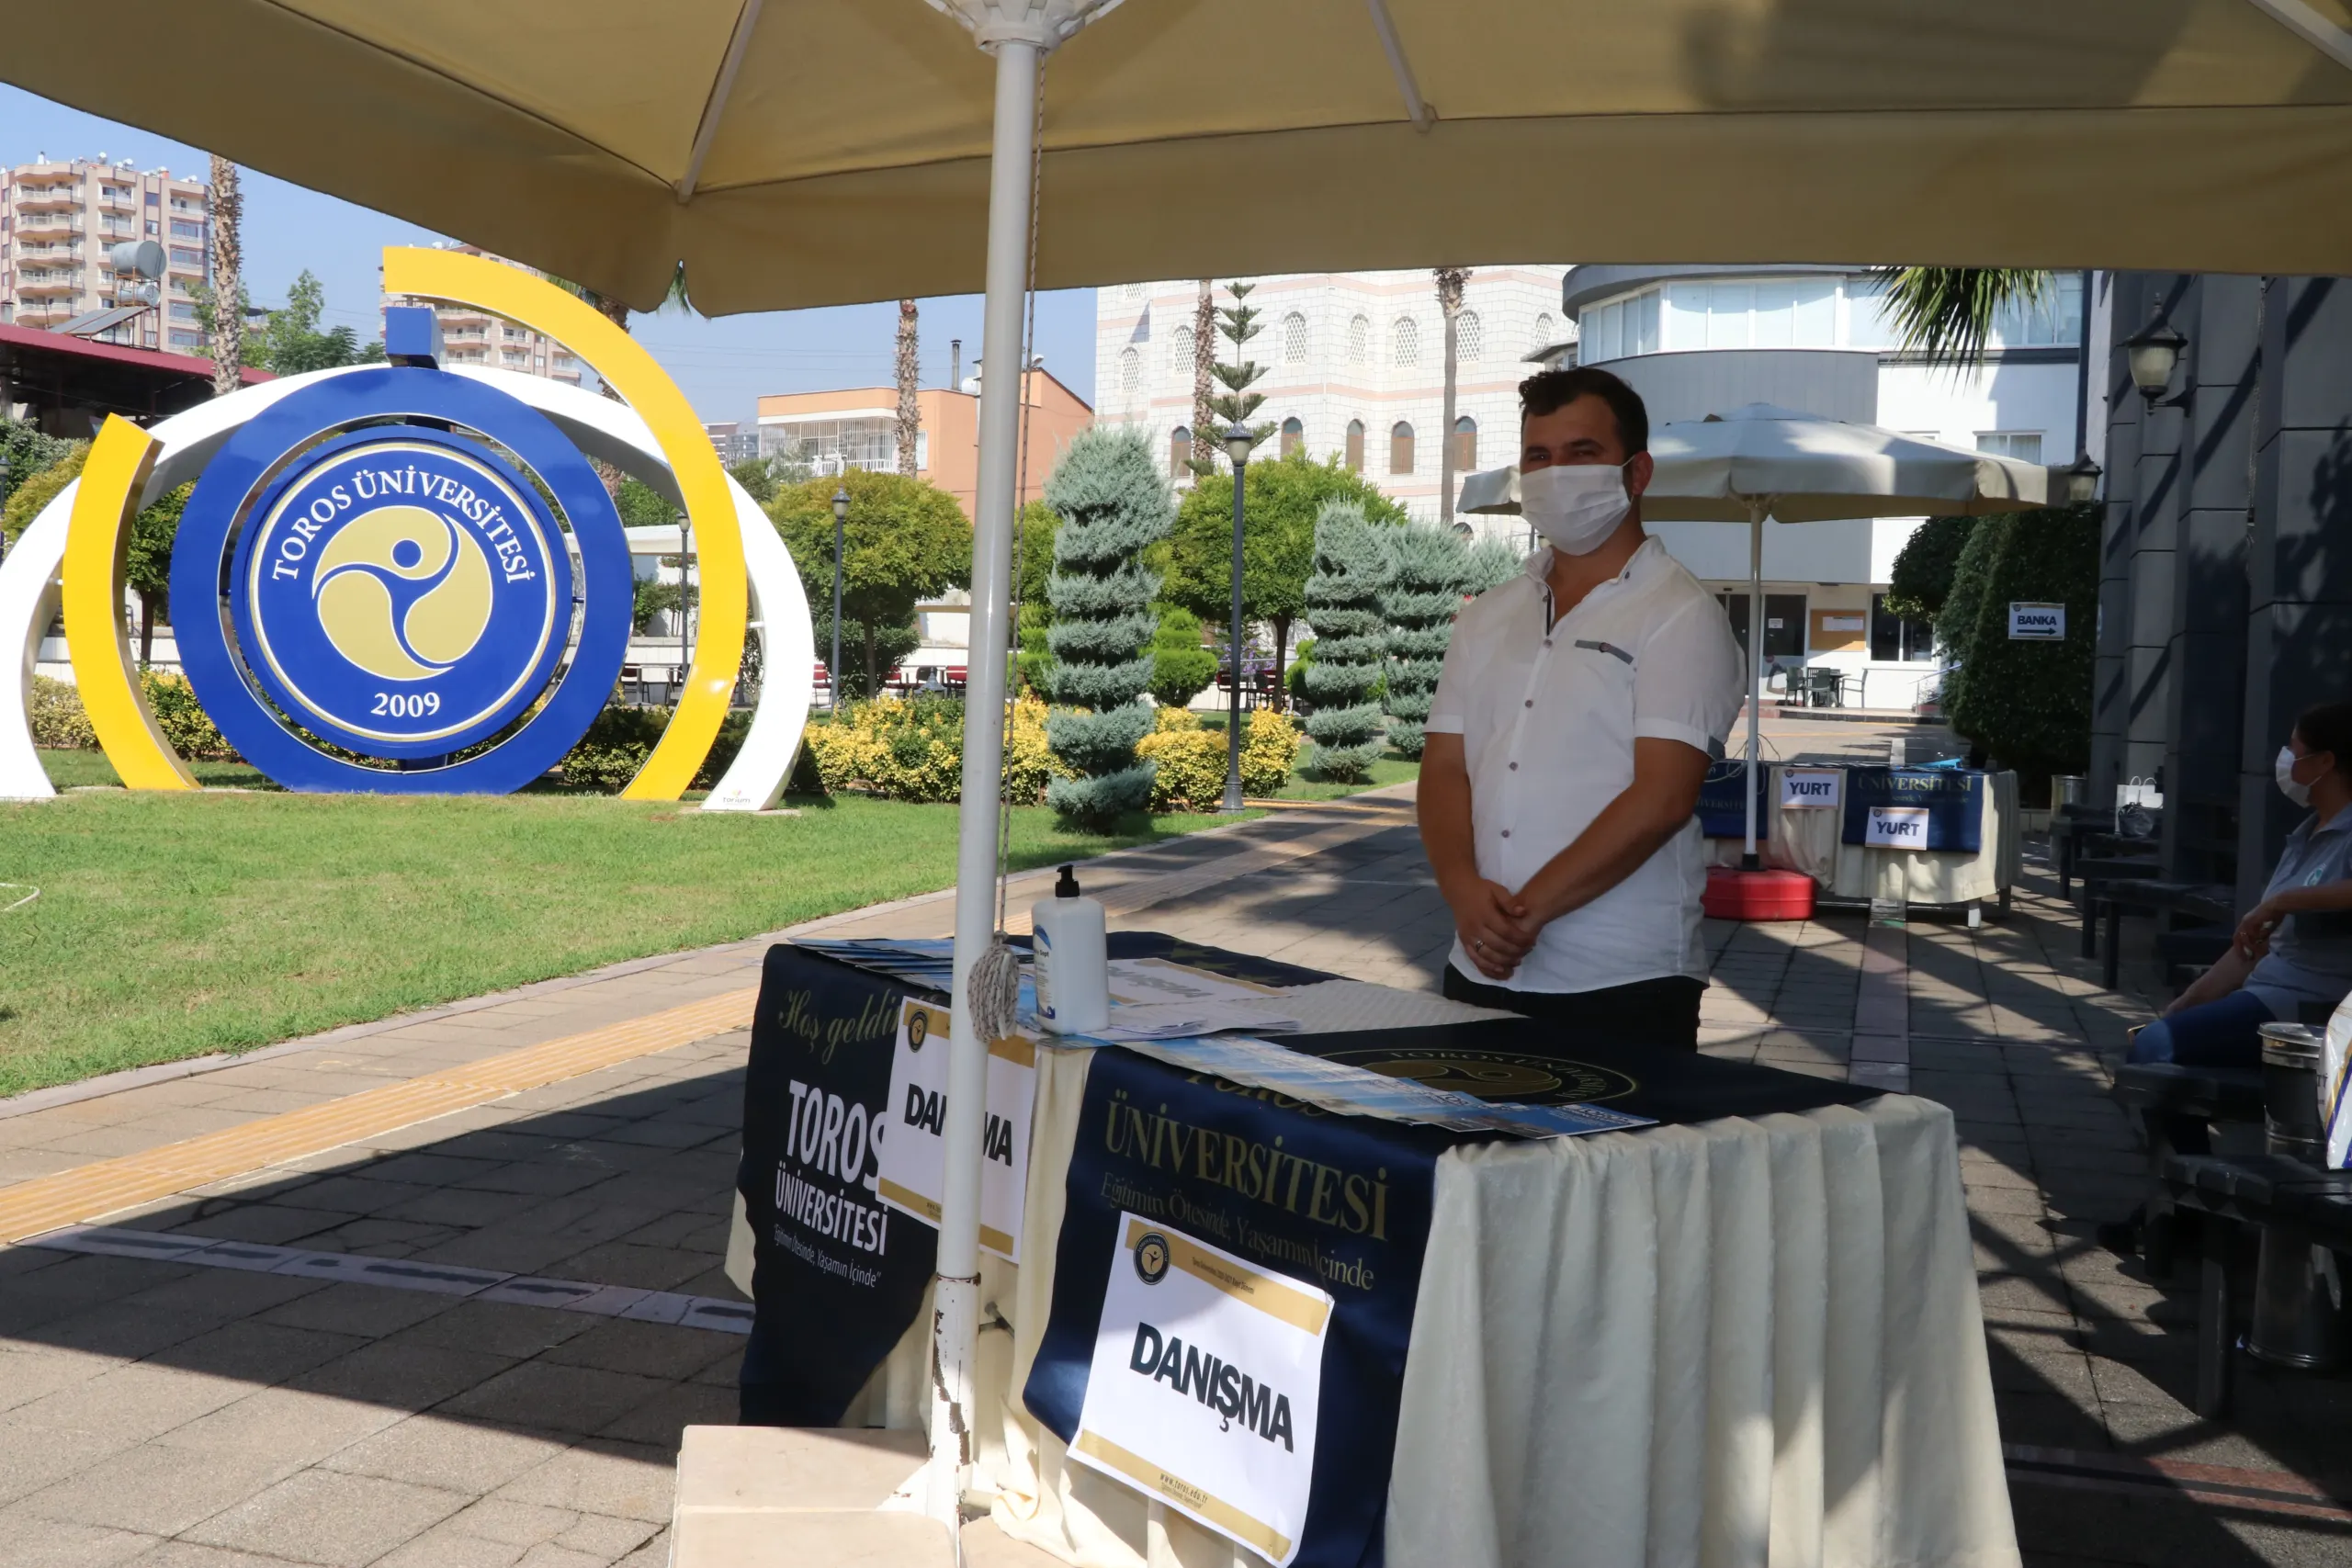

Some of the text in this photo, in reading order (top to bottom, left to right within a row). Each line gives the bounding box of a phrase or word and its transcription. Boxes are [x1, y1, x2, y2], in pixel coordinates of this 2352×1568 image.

[272, 465, 536, 584] TOROS ÜNİVERSİTESİ
[2017, 615, 2058, 626] BANKA
[370, 692, 441, 718] 2009
[1789, 782, 1832, 795] YURT
[1876, 821, 1920, 837] YURT
[777, 988, 825, 1055] Hoş
[1105, 1088, 1390, 1242] ÜNİVERSİTESİ
[775, 1160, 889, 1257] ÜNİVERSİTESİ
[1129, 1321, 1295, 1454] DANIŞMA
